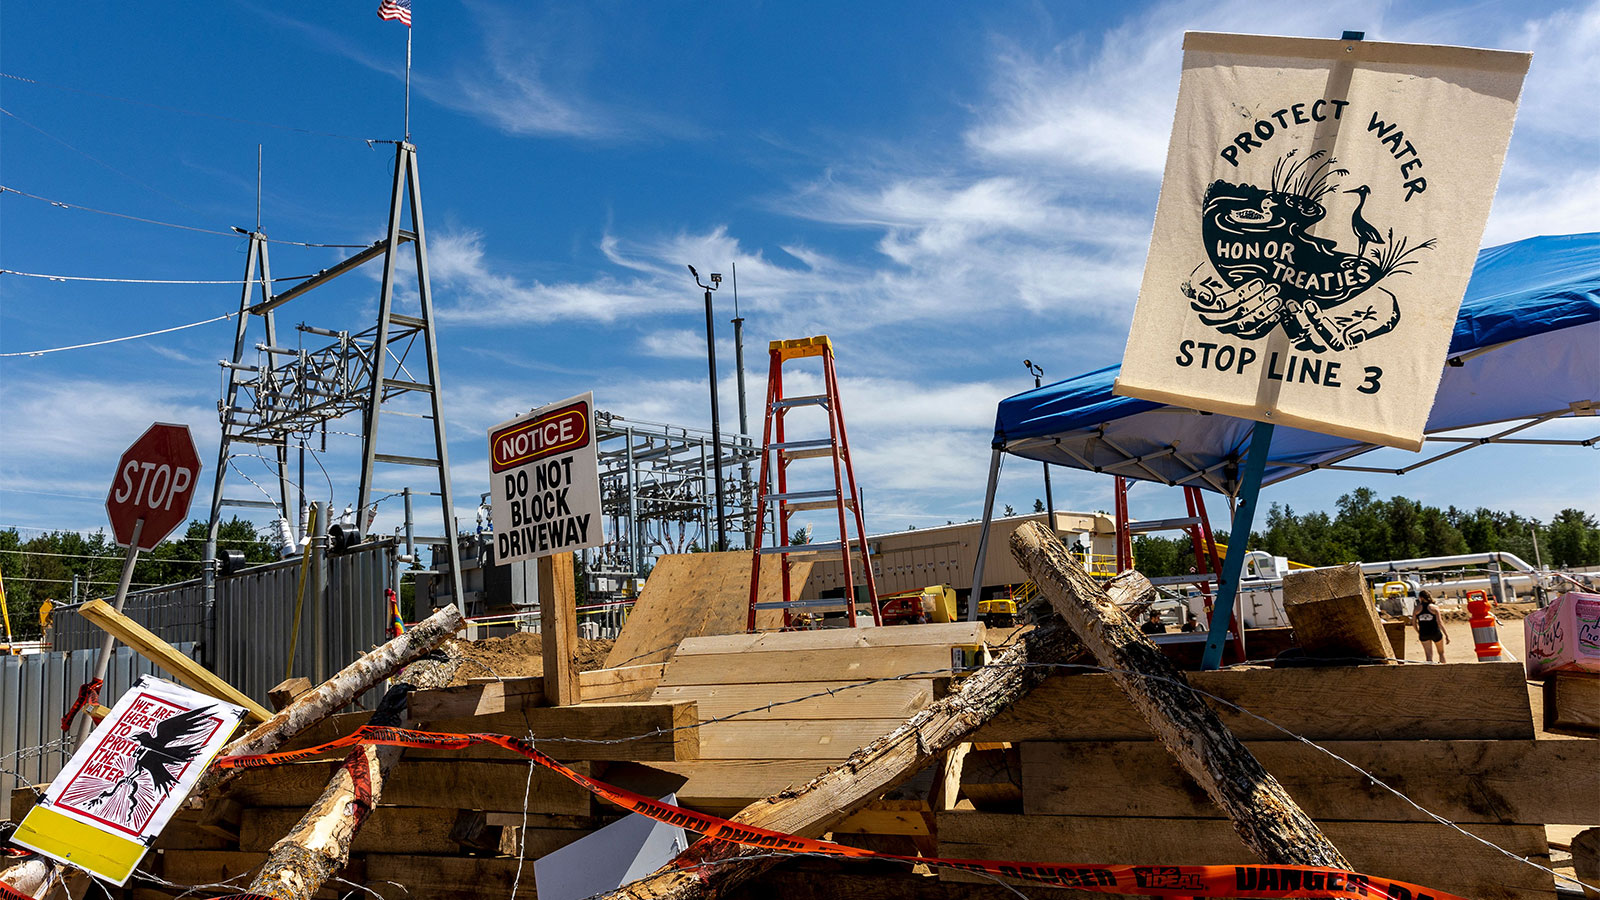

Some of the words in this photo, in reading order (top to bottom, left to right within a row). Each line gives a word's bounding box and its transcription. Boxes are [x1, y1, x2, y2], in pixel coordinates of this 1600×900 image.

[1220, 99, 1350, 167] PROTECT
[1367, 112, 1427, 202] WATER
[1217, 238, 1294, 262] HONOR
[1272, 260, 1371, 292] TREATIES
[1176, 340, 1256, 375] STOP
[1268, 352, 1341, 388] LINE
[1357, 366, 1383, 394] 3
[502, 418, 574, 460] NOTICE
[115, 460, 191, 511] STOP
[505, 470, 528, 501] DO
[536, 456, 573, 492] NOT
[511, 487, 570, 528] BLOCK
[499, 513, 591, 559] DRIVEWAY
[124, 711, 155, 730] HERE
[133, 699, 154, 714] WE
[152, 706, 175, 720] ARE
[115, 722, 131, 736] TO
[84, 760, 124, 784] WATER
[94, 749, 120, 766] THE
[1145, 874, 1204, 890] IDEAL
[1235, 866, 1369, 897] DANGER
